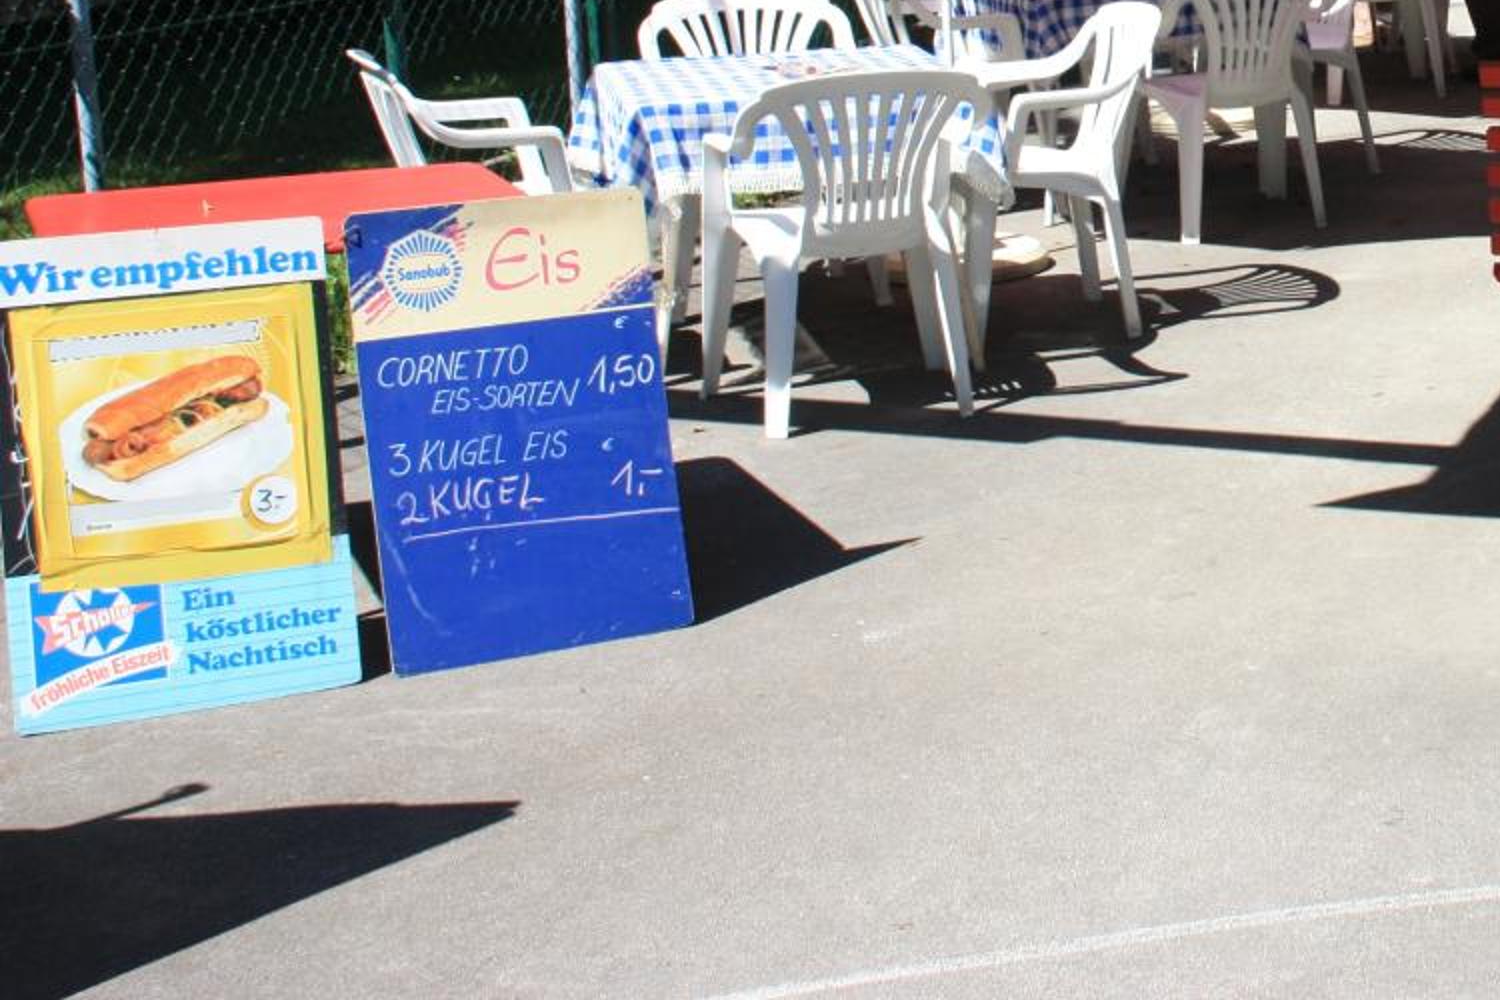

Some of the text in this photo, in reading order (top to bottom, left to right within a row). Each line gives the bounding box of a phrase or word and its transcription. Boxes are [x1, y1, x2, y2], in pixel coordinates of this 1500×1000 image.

[0, 246, 318, 297] Wir empfehlen
[485, 227, 580, 291] Eis
[377, 344, 529, 389] CORNETTO
[431, 354, 655, 415] EIS-SORTEN 1,50
[389, 443, 412, 477] 3
[418, 434, 506, 474] KUGEL
[523, 429, 569, 462] EIS
[397, 492, 430, 526] 2
[429, 472, 545, 519] KUGEL
[182, 587, 236, 612] Ein
[185, 605, 342, 643] köstlicher
[31, 645, 170, 711] fröhliche Eiszeit
[187, 635, 338, 675] Nachtisch
